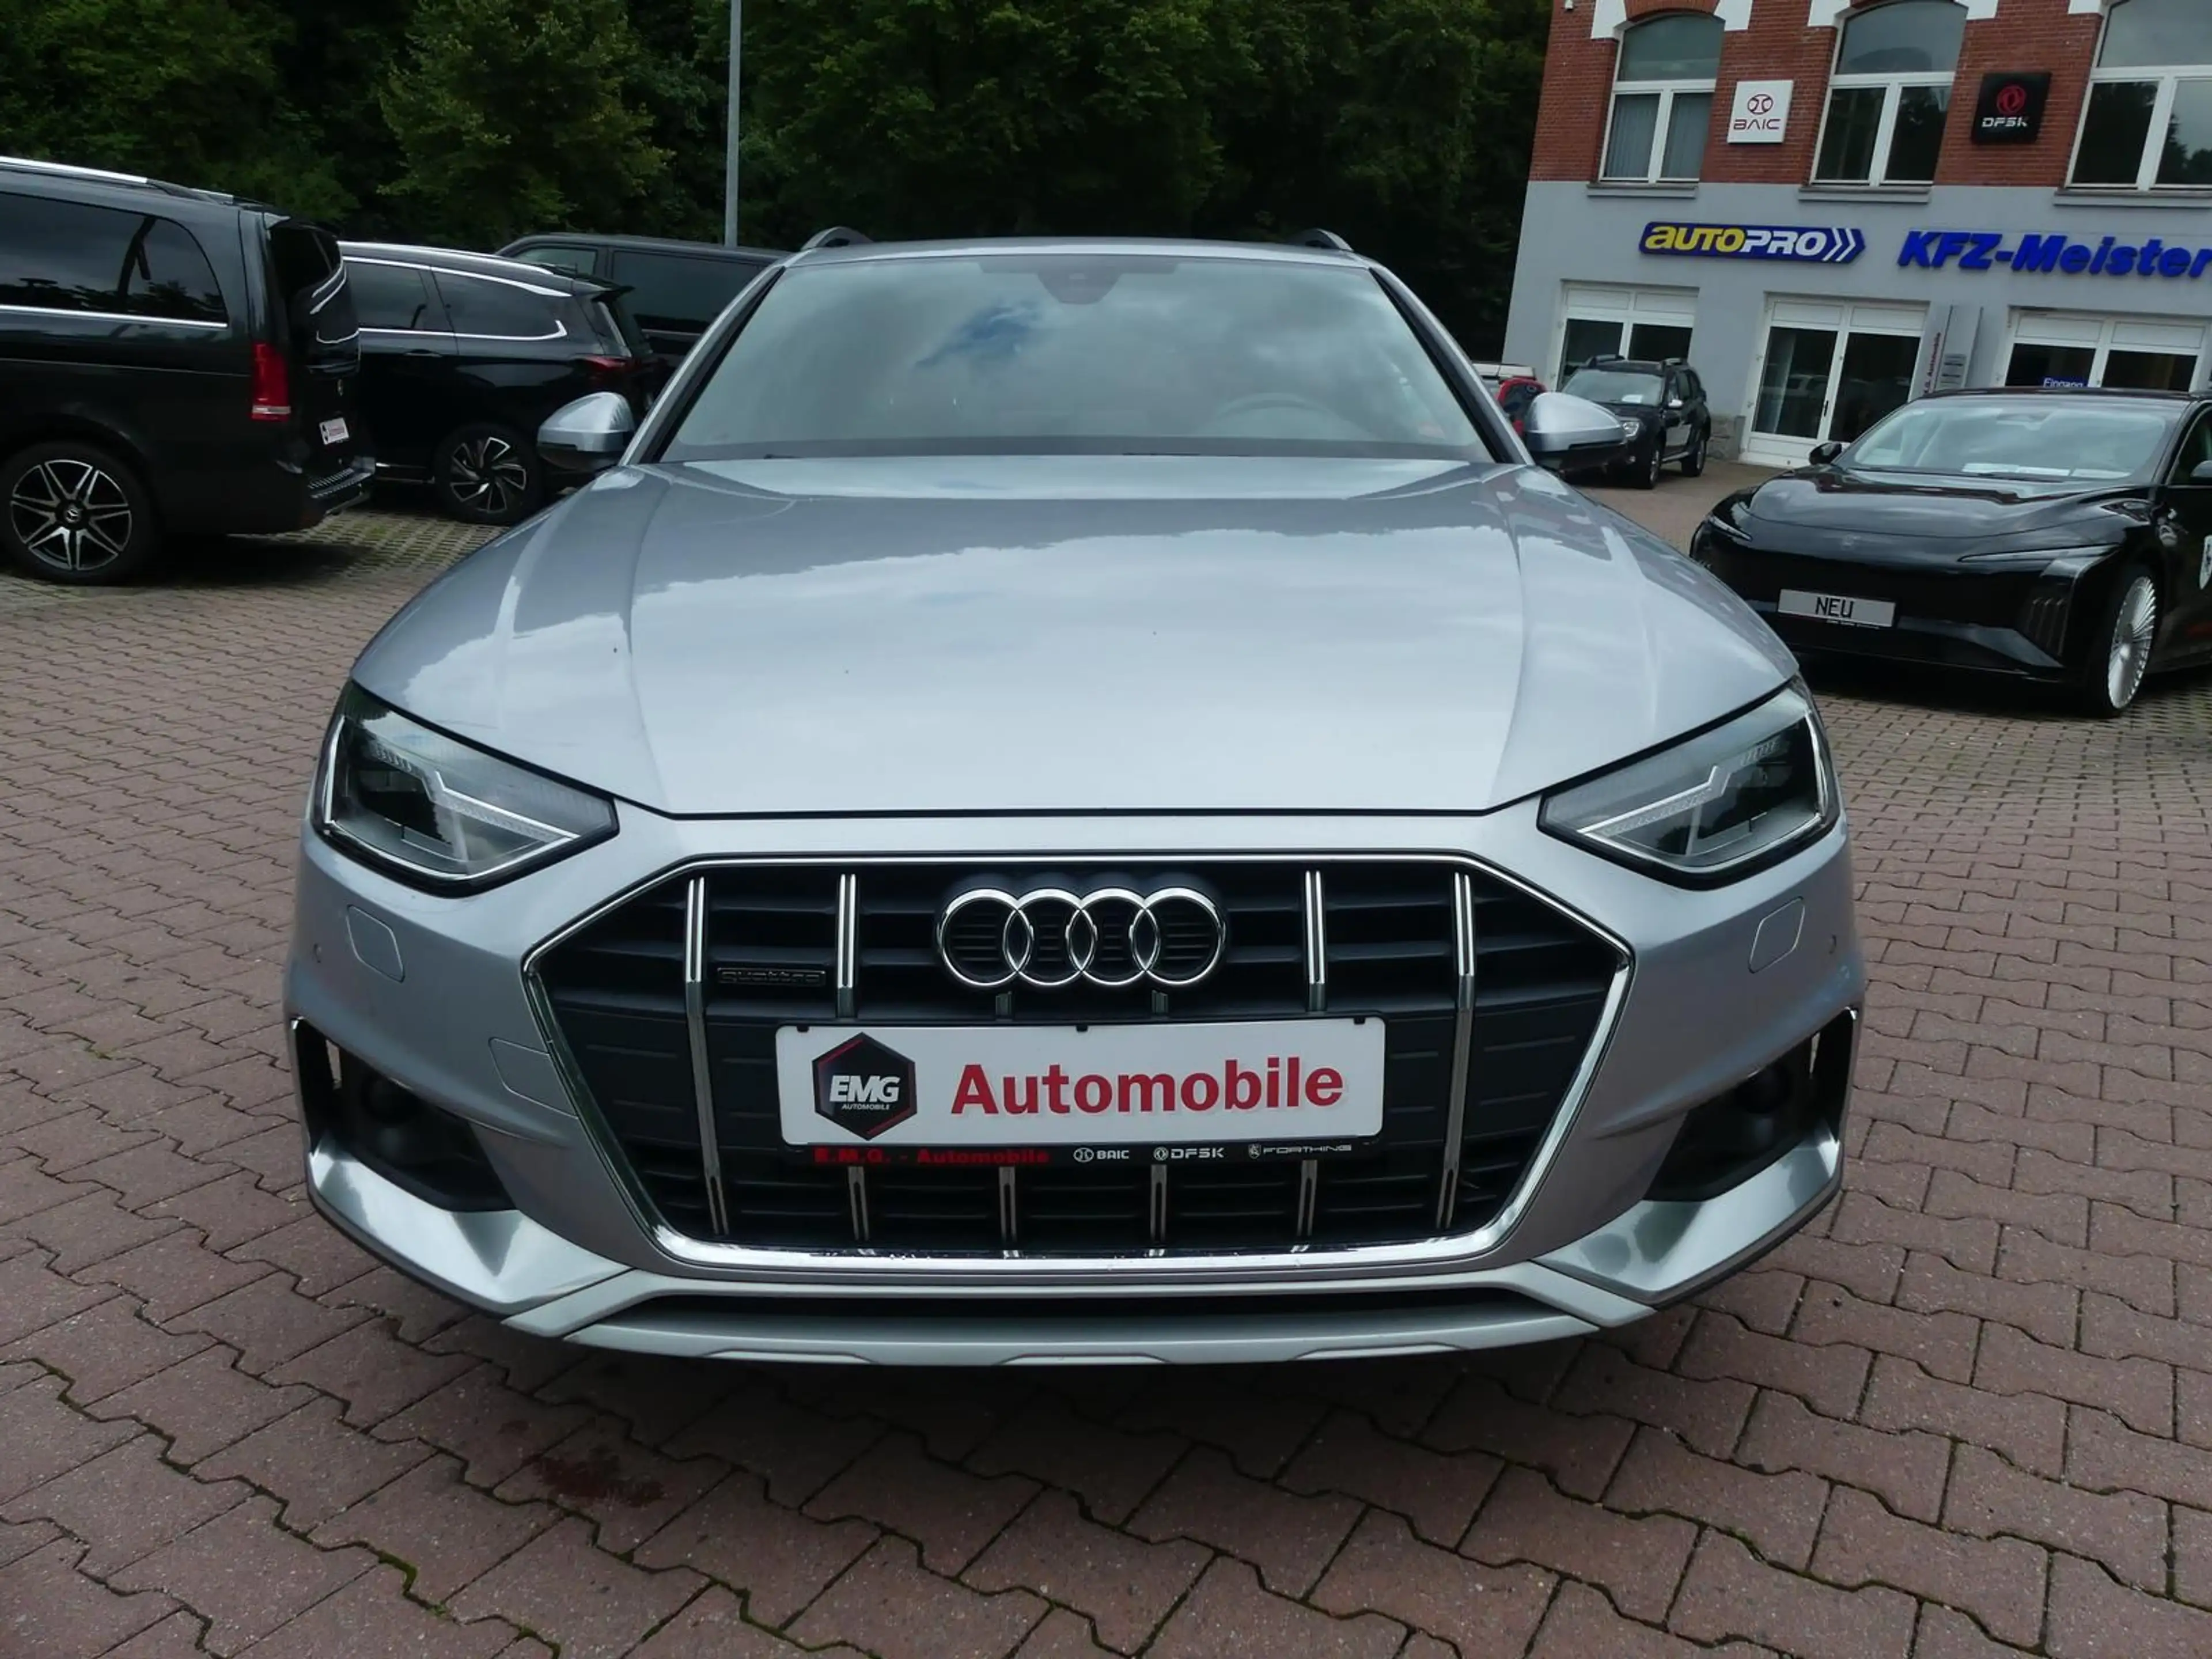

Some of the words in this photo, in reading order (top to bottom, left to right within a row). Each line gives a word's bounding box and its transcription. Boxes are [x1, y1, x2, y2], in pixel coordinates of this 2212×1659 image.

[1733, 118, 1781, 130] BAIC
[1982, 117, 2028, 127] DFSK
[1897, 230, 2212, 278] KFZ-Meister
[1815, 597, 1854, 618] NEU
[829, 1075, 901, 1103] EMG
[950, 1056, 1344, 1115] Automobile
[917, 1147, 1050, 1164] Automobile
[1096, 1150, 1130, 1160] BAIC
[1171, 1147, 1225, 1158] DFSK
[1263, 1143, 1353, 1154] FORTHING
